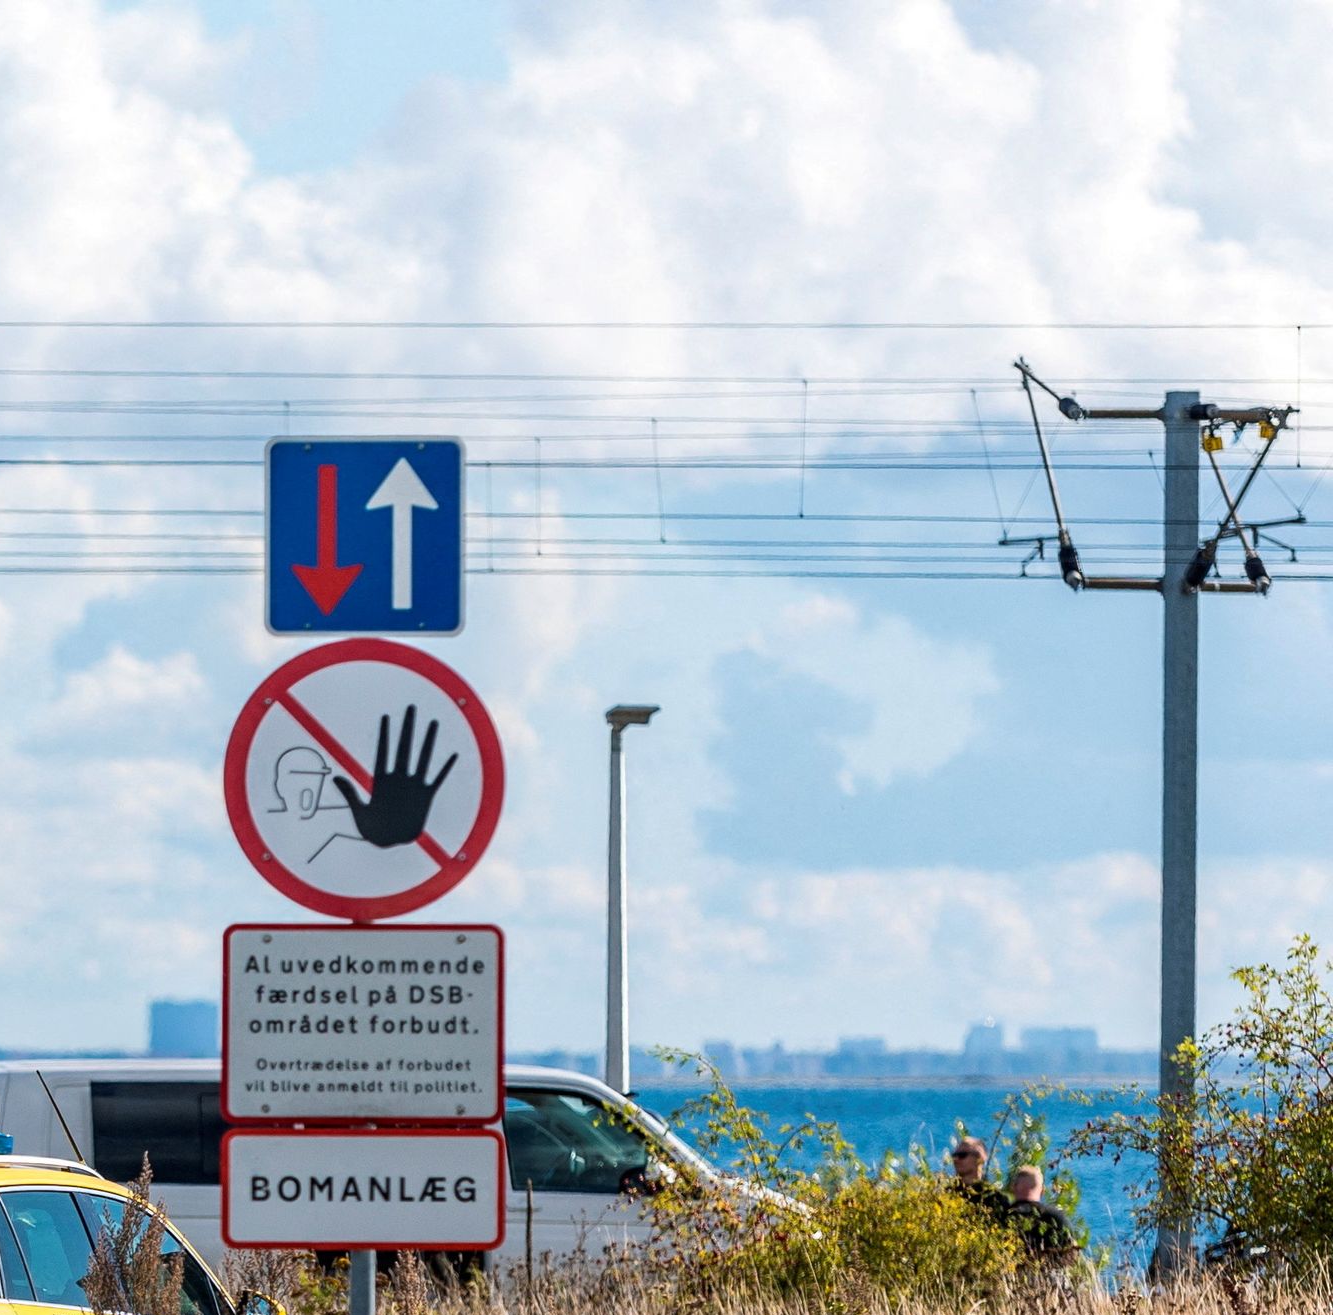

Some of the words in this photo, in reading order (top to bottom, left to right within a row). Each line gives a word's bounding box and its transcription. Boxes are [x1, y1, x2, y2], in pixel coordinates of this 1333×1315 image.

[244, 955, 271, 974] Al
[281, 955, 486, 974] uvedkommende
[255, 985, 358, 1004] færdsel
[368, 985, 397, 1007] på
[409, 985, 474, 1004] DSB-
[249, 1015, 358, 1034] området
[369, 1015, 480, 1034] forbudt.
[255, 1057, 369, 1072] Overtrædelse
[376, 1057, 392, 1072] af
[398, 1057, 472, 1072] forbudet
[245, 1080, 266, 1093] vil
[271, 1080, 311, 1093] blive
[316, 1080, 384, 1093] anmeldt
[390, 1080, 409, 1093] til
[414, 1080, 483, 1095] politiet.
[250, 1175, 477, 1203] BOMANLÆG
